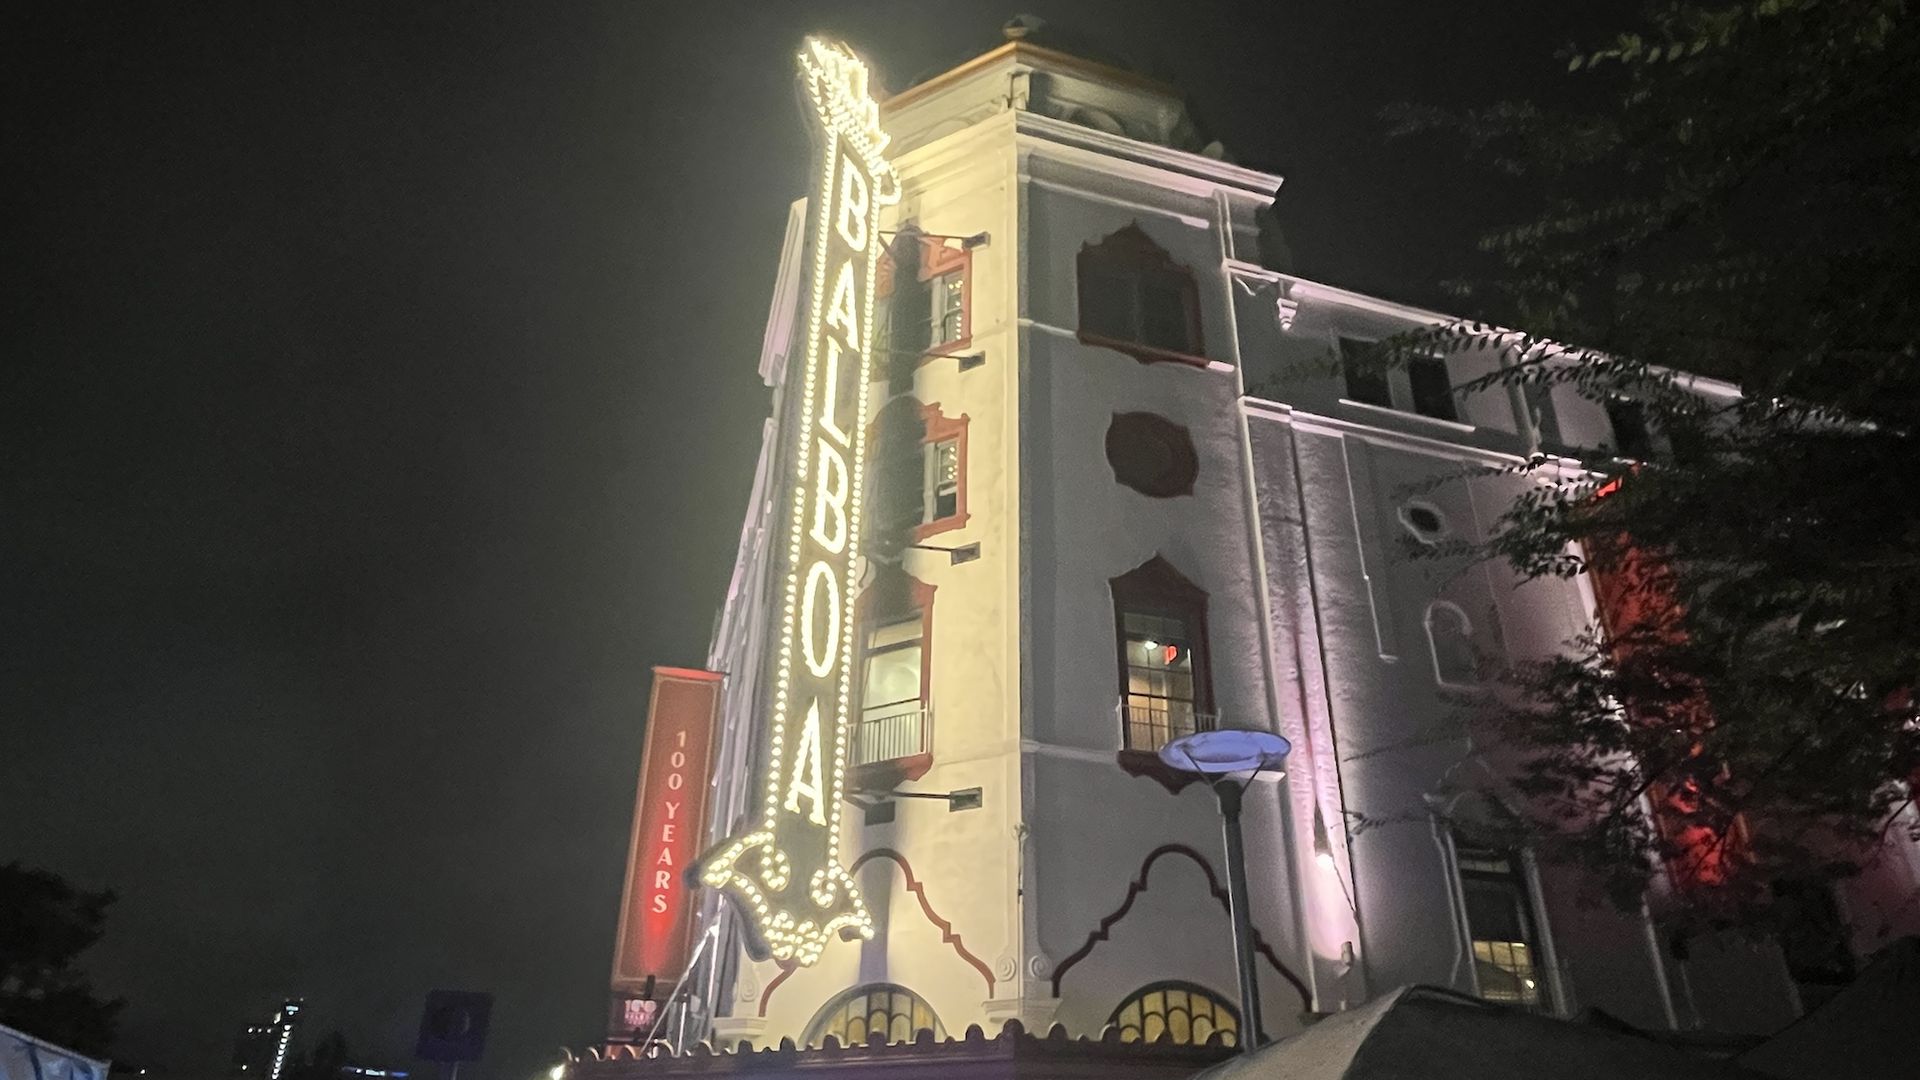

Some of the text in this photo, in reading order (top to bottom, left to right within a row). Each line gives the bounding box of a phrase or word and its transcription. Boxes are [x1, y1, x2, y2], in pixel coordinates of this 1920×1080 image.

[784, 152, 869, 827] BALBOA
[652, 730, 687, 914] 100 YEARS
